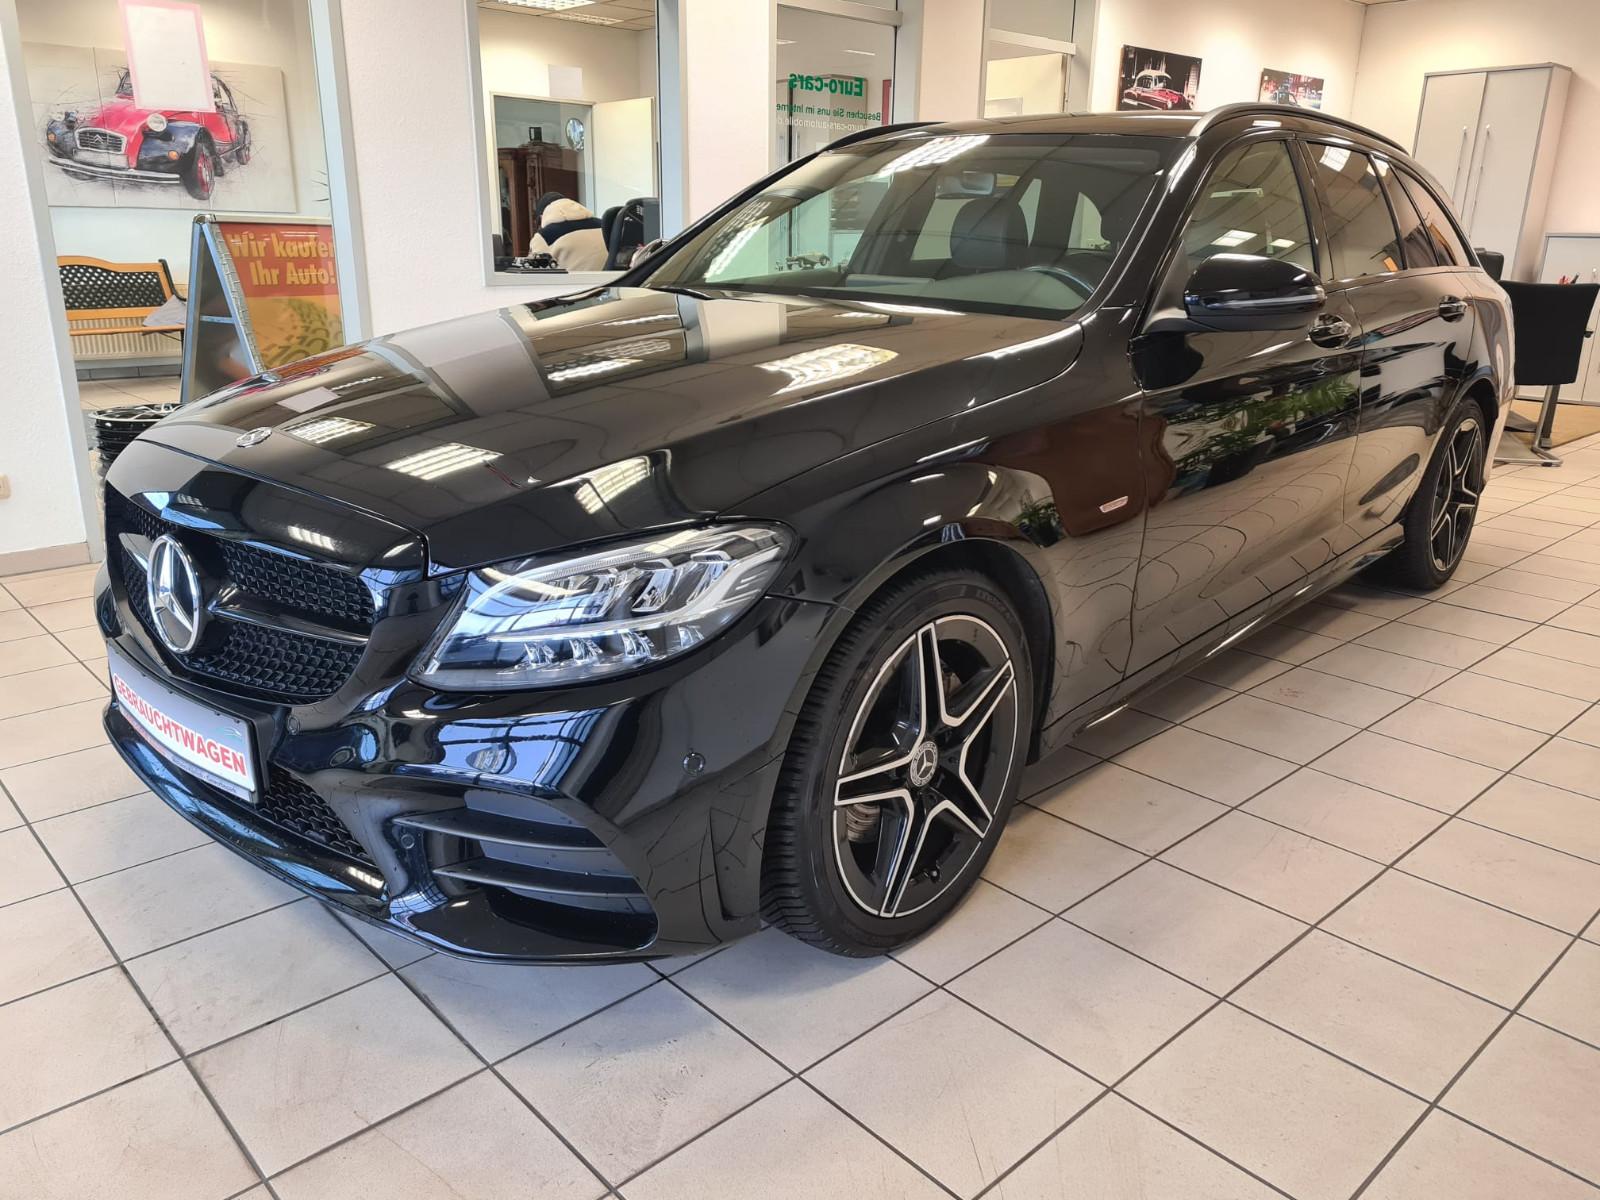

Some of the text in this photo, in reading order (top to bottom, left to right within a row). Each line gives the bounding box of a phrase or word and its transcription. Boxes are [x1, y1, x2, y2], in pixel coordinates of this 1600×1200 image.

[225, 232, 267, 257] Wir
[249, 260, 336, 285] Ihr Auto!
[114, 674, 247, 776] GEBRAUCHTWAGEN
